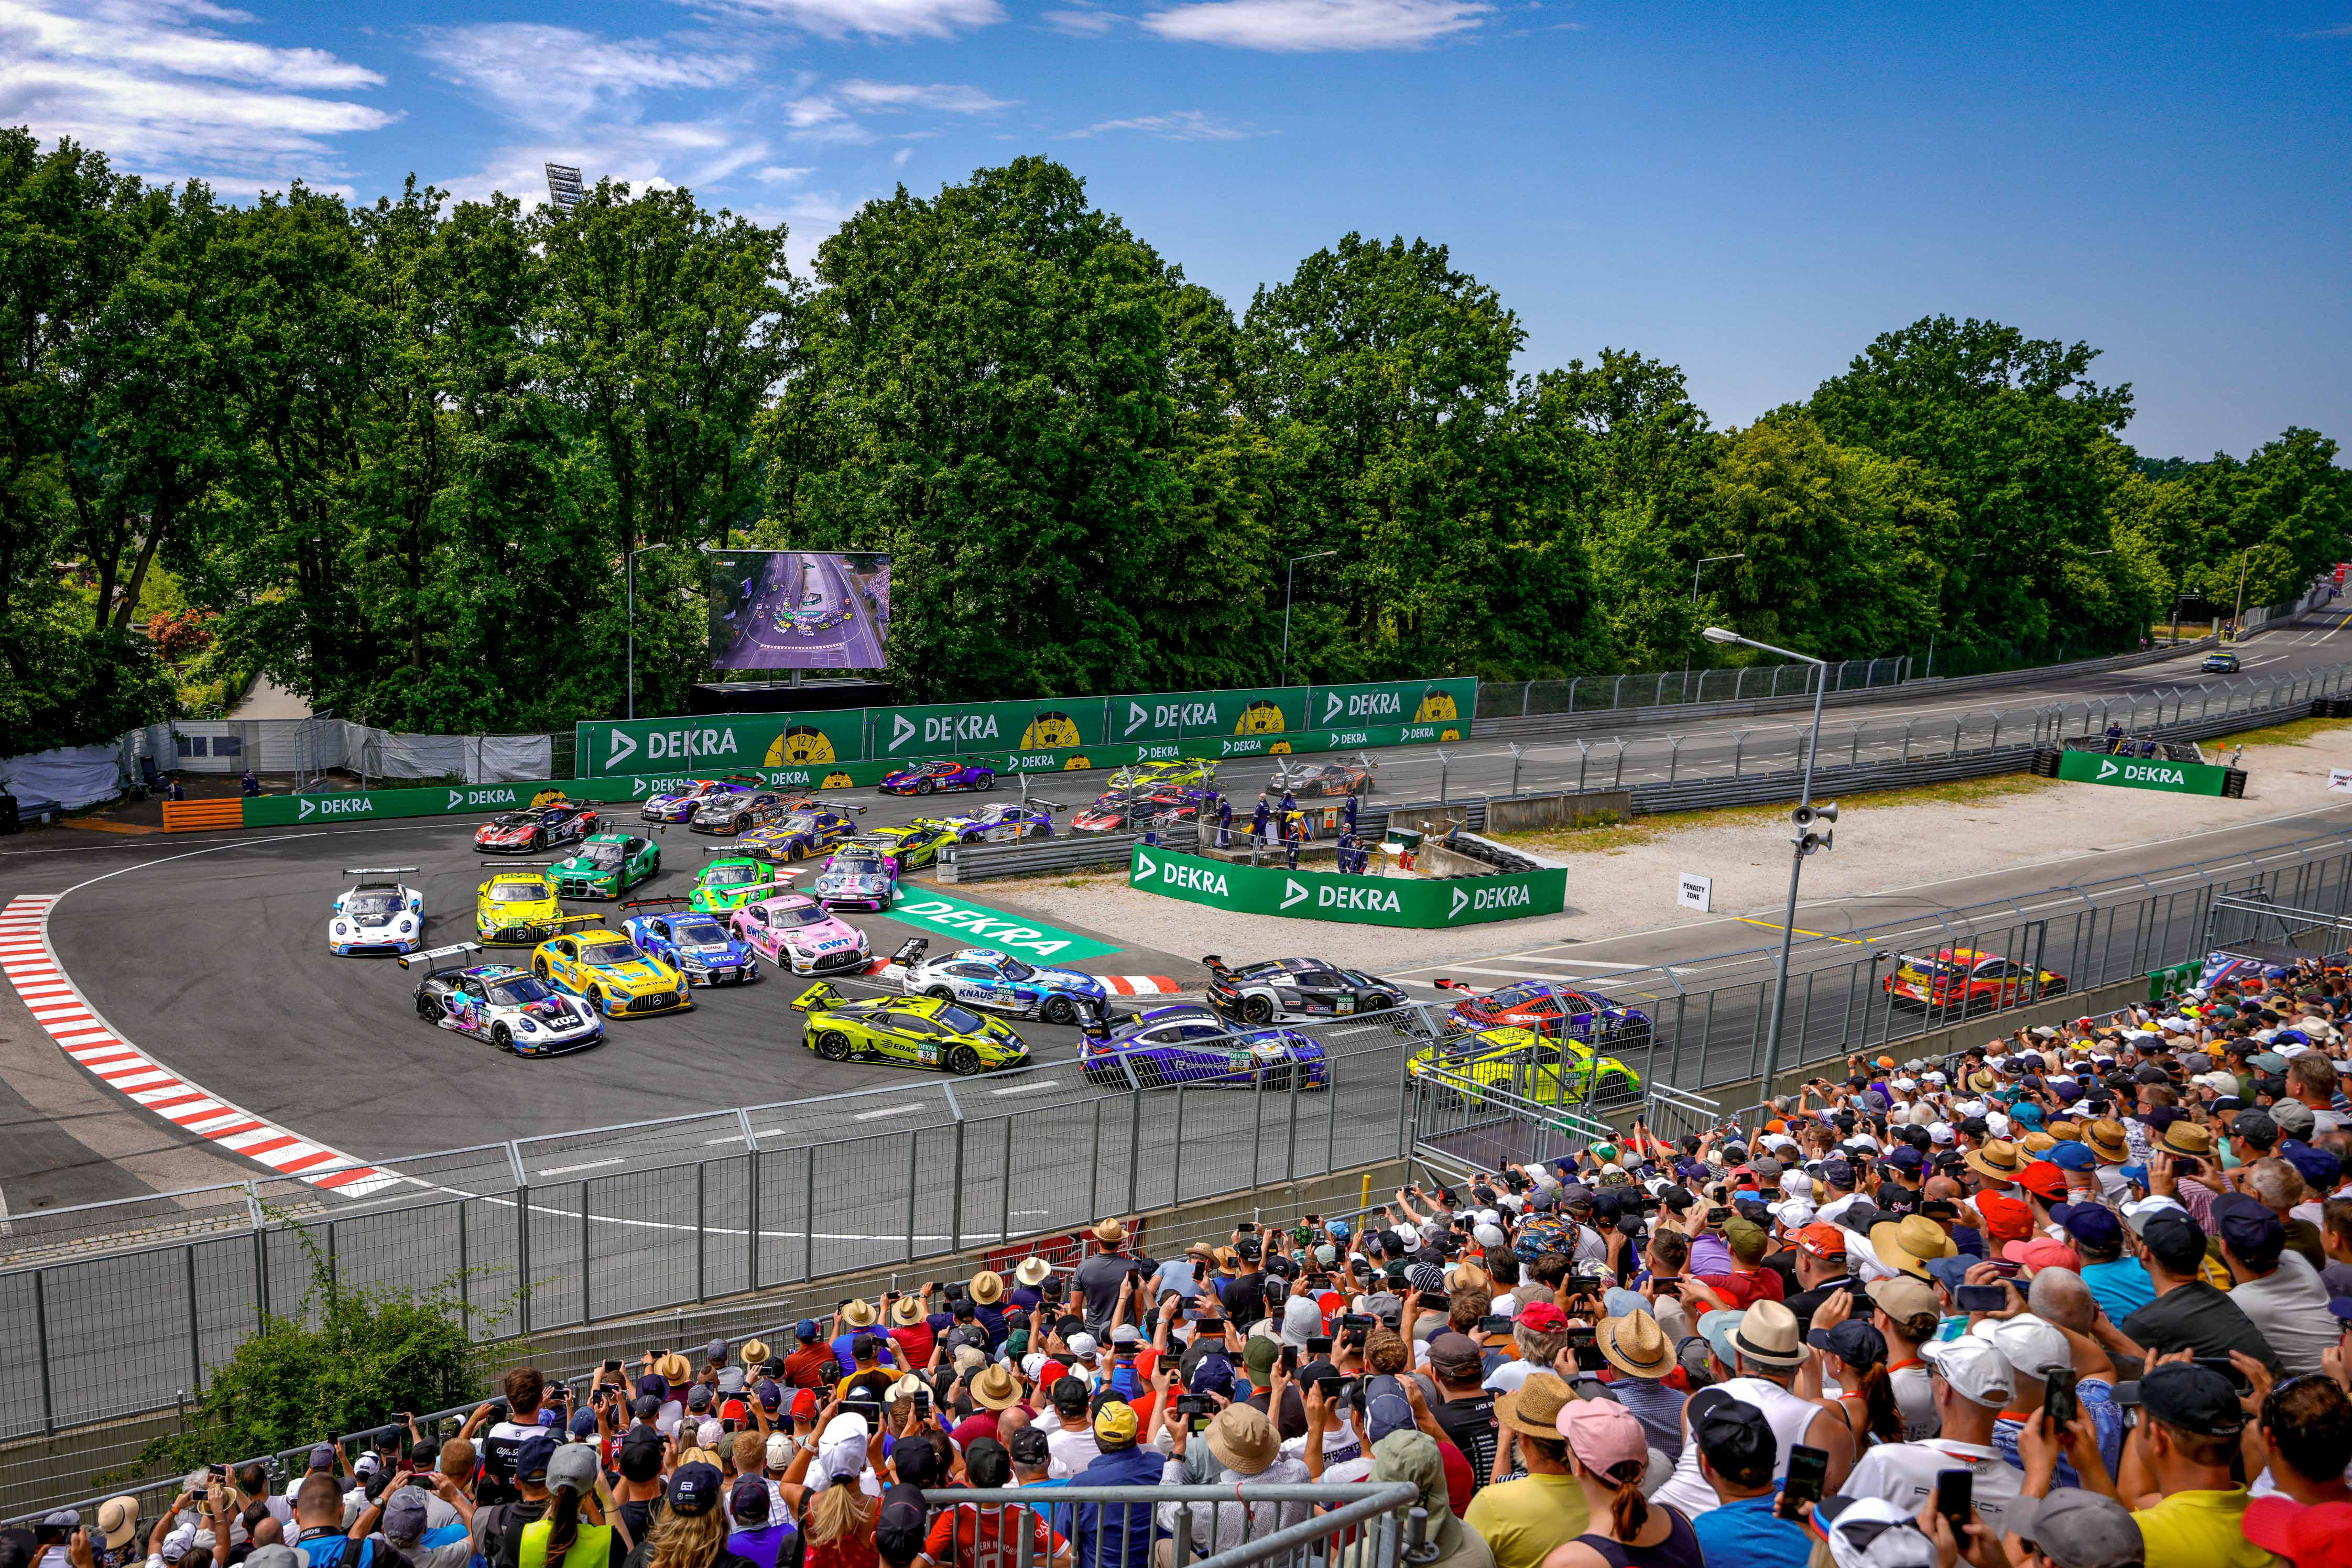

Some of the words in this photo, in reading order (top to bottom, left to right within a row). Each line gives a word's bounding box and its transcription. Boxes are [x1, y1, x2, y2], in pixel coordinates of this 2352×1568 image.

[1348, 692, 1401, 716] DEKRA
[1155, 702, 1217, 727] DEKRA
[924, 714, 999, 743] DEKRA
[1410, 727, 1434, 738] DEKRA
[648, 727, 738, 759] DEKRA
[1341, 732, 1367, 744] DEKRA
[1233, 739, 1262, 752] DEKRA
[1150, 746, 1179, 758] DEKRA
[1022, 754, 1055, 768] DEKRA
[771, 771, 810, 785] DEKRA
[2125, 765, 2185, 785] DEKRA
[469, 789, 516, 805] DEKRA
[321, 797, 373, 814] DEKRA
[823, 830, 842, 839] MANNOL
[1163, 862, 1229, 897] DEKRA
[1683, 882, 1705, 893] PENALTY
[1319, 885, 1401, 913] DEKRA
[1474, 884, 1530, 910] DEKRA
[1686, 892, 1700, 900] ZONE
[747, 924, 760, 939] BWT
[896, 901, 1073, 956] DEKRA
[818, 939, 850, 951] BWT
[717, 973, 737, 983] ABT
[1006, 970, 1017, 978] 22
[492, 987, 503, 997] 75
[959, 989, 994, 1000] KNAUS
[478, 1008, 491, 1016] DEKRA
[536, 1002, 555, 1012] 75
[443, 1019, 456, 1029] HYLO
[549, 1015, 579, 1028] KÜS
[1150, 1014, 1201, 1024] RoboMarkets
[893, 1043, 917, 1054] EDAG
[496, 1446, 513, 1457] Alfa
[1965, 1462, 1987, 1473] BOSS
[301, 1528, 320, 1538] SONY
